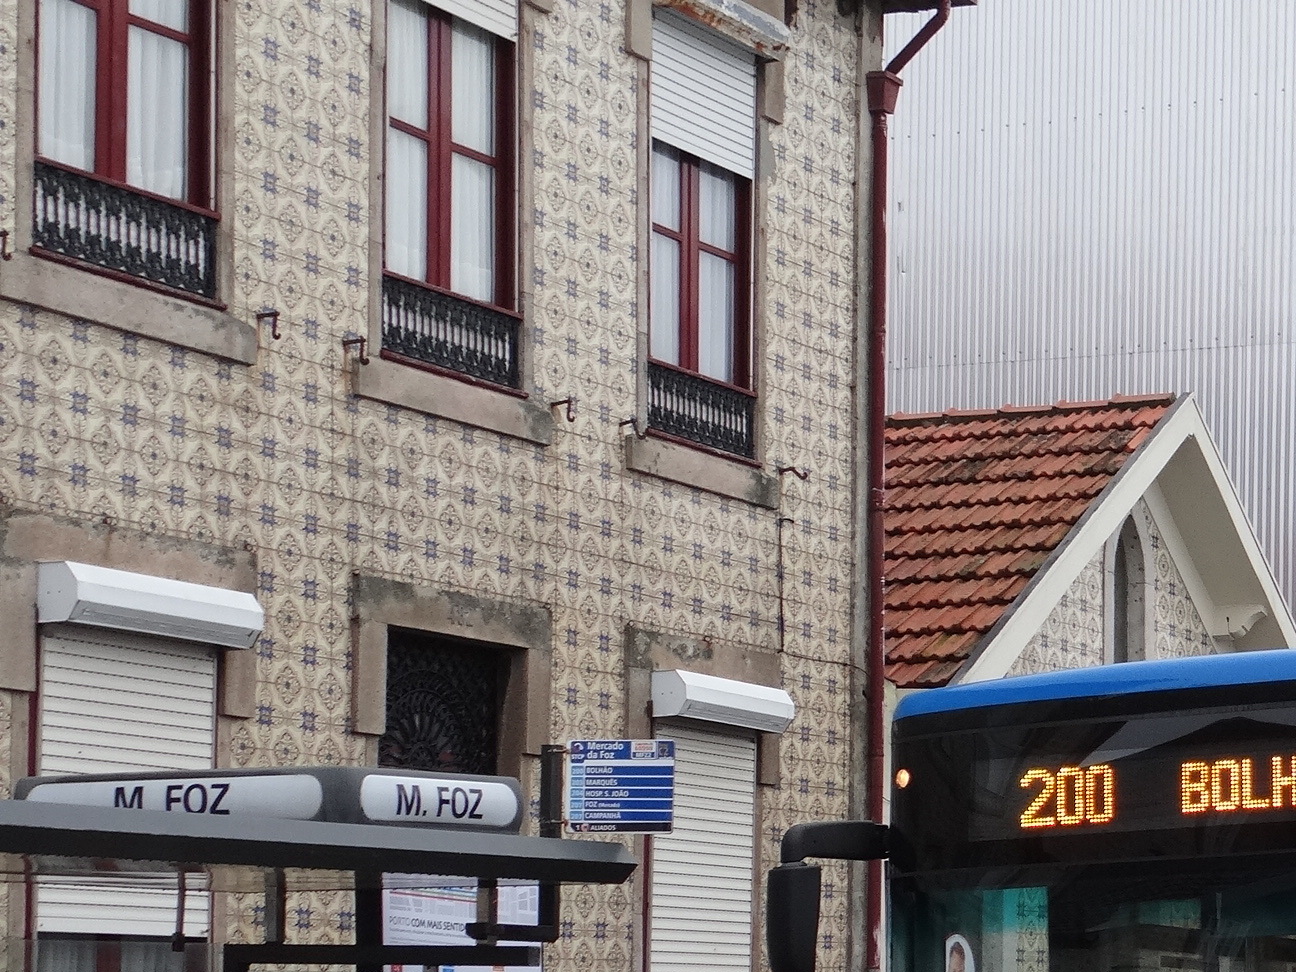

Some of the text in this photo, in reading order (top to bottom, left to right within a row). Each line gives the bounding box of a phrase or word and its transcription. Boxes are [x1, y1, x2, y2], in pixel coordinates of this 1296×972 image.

[587, 742, 624, 750] Mercado
[587, 751, 615, 759] da Foz
[586, 766, 613, 774] BOLHÃO
[586, 778, 618, 786] MARQUÊS
[611, 789, 629, 797] JOÃO
[1019, 764, 1114, 828] 200
[165, 783, 231, 815] FOZ
[396, 784, 484, 819] M. FOZ
